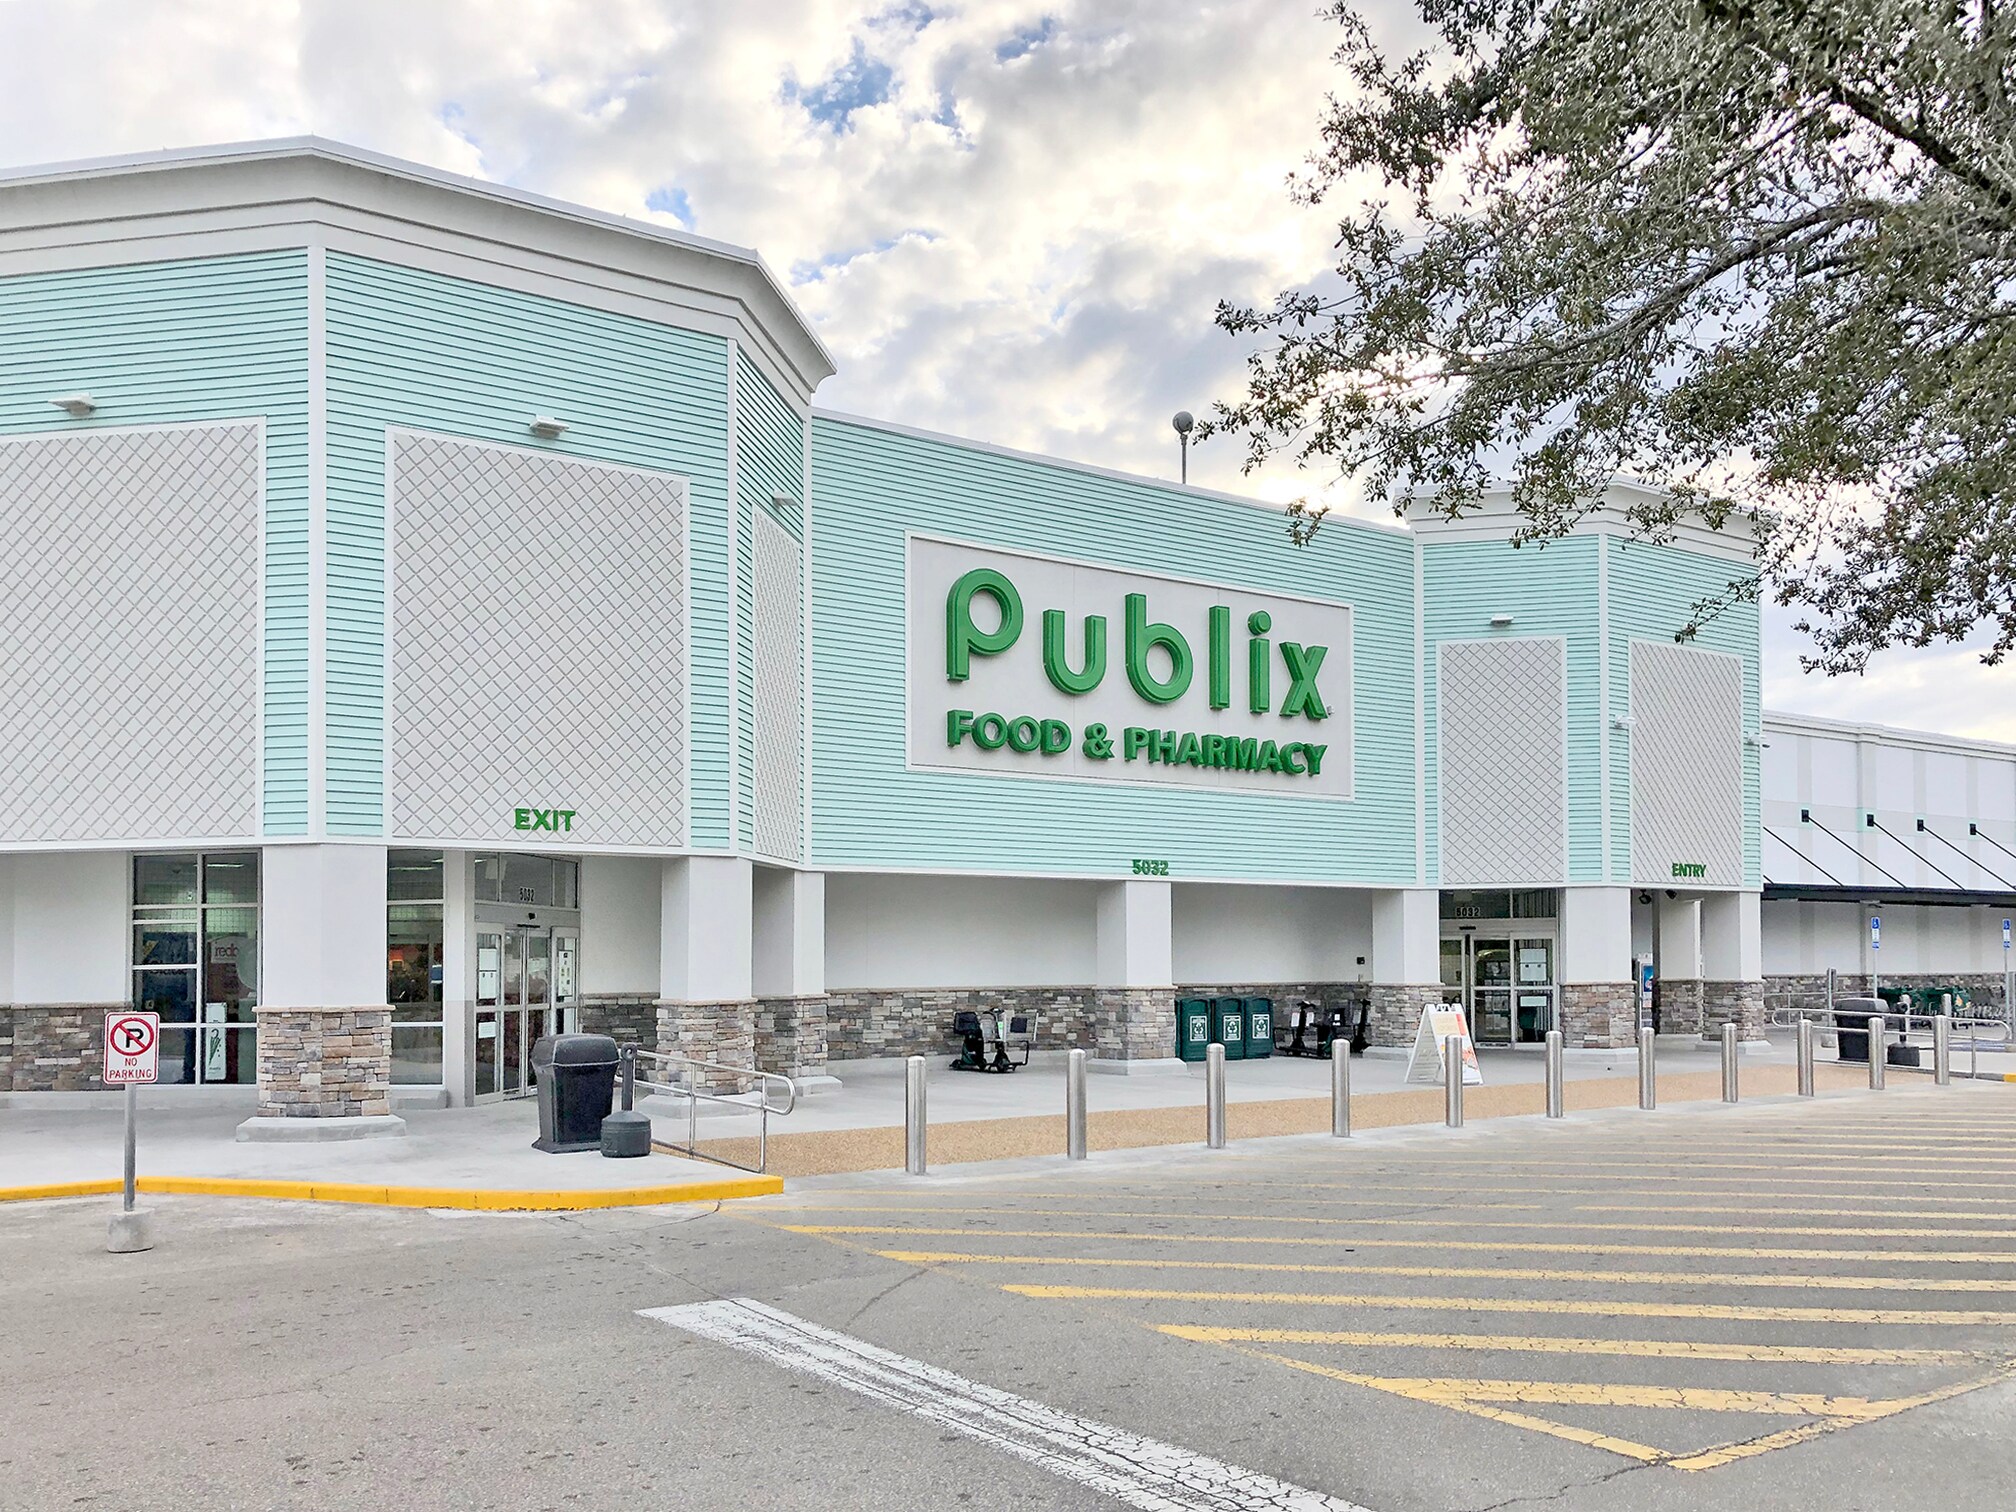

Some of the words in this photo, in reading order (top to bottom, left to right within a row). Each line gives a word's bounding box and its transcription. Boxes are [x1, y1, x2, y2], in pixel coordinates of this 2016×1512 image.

[945, 567, 1329, 721] Publix
[946, 709, 1073, 755] FOOD
[1082, 722, 1116, 760] &
[1123, 726, 1329, 776] PHARMACY
[514, 808, 577, 832] EXIT
[1131, 858, 1170, 876] 5032
[1671, 862, 1707, 878] ENTRY
[519, 886, 535, 903] 5032
[1456, 907, 1480, 917] 5032
[124, 1057, 138, 1067] NO
[109, 1068, 152, 1079] PARKING
